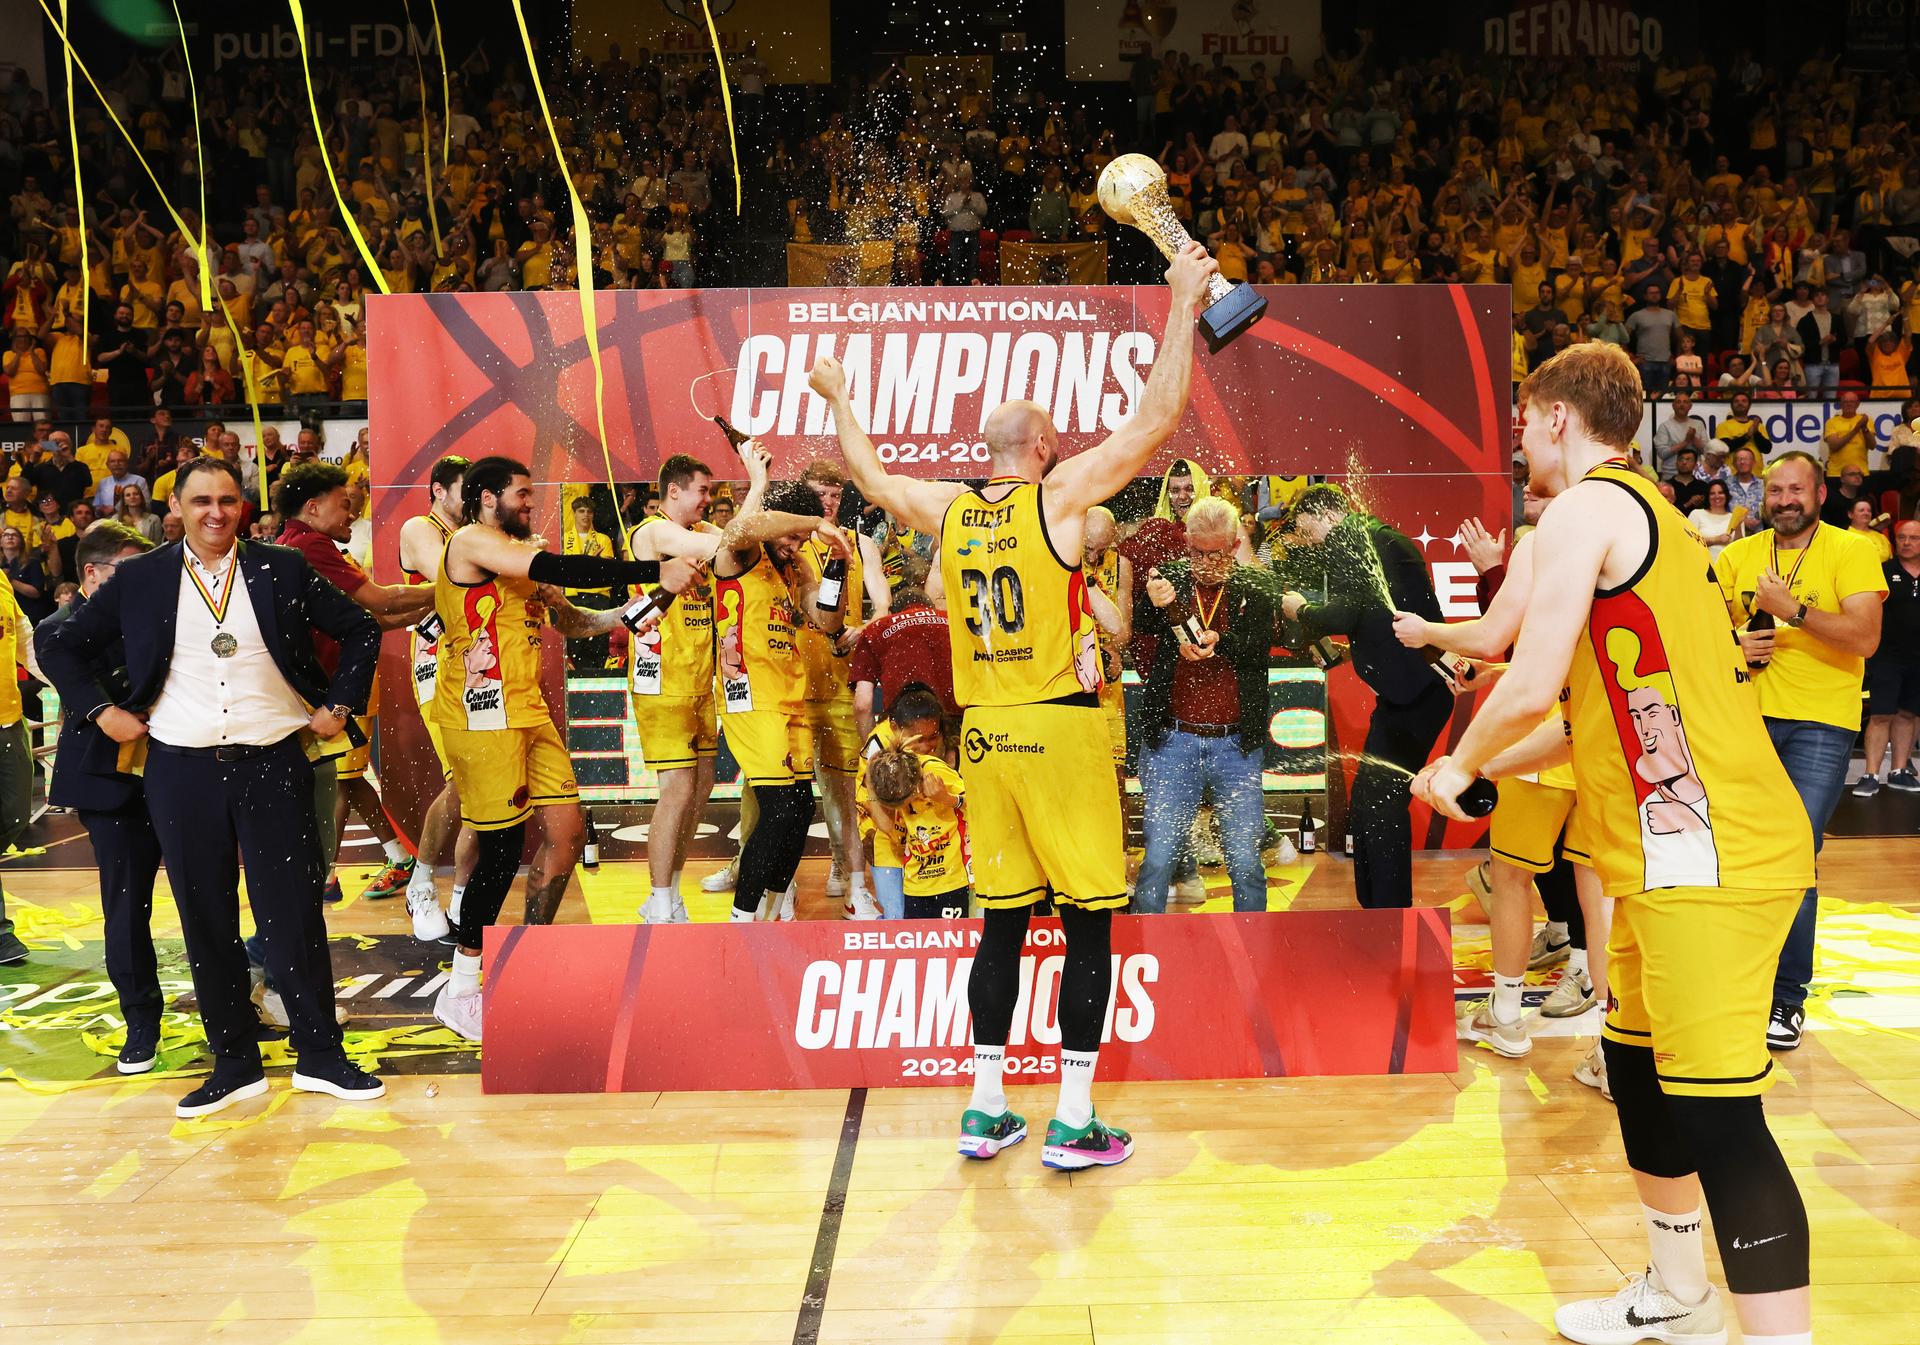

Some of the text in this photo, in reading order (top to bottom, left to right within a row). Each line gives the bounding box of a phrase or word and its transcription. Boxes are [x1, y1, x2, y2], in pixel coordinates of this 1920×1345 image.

[1484, 0, 1663, 61] DEFRANCQ
[214, 24, 442, 71] publi-FDM
[1202, 34, 1289, 55] FILOU
[788, 301, 1097, 323] BELGIAN NATIONAL
[730, 331, 1155, 436] CHAMPIONS
[876, 443, 992, 463] 024-20
[961, 565, 1025, 636] 30
[996, 647, 1033, 657] CASINO
[466, 688, 499, 703] COWBOY
[470, 699, 500, 712] HENK
[989, 733, 1009, 742] Port
[996, 743, 1045, 754] Oostende
[844, 929, 1067, 950] BELGIAN NION
[795, 954, 1160, 1049] CHAMIOS
[902, 1056, 1057, 1077] 2024025
